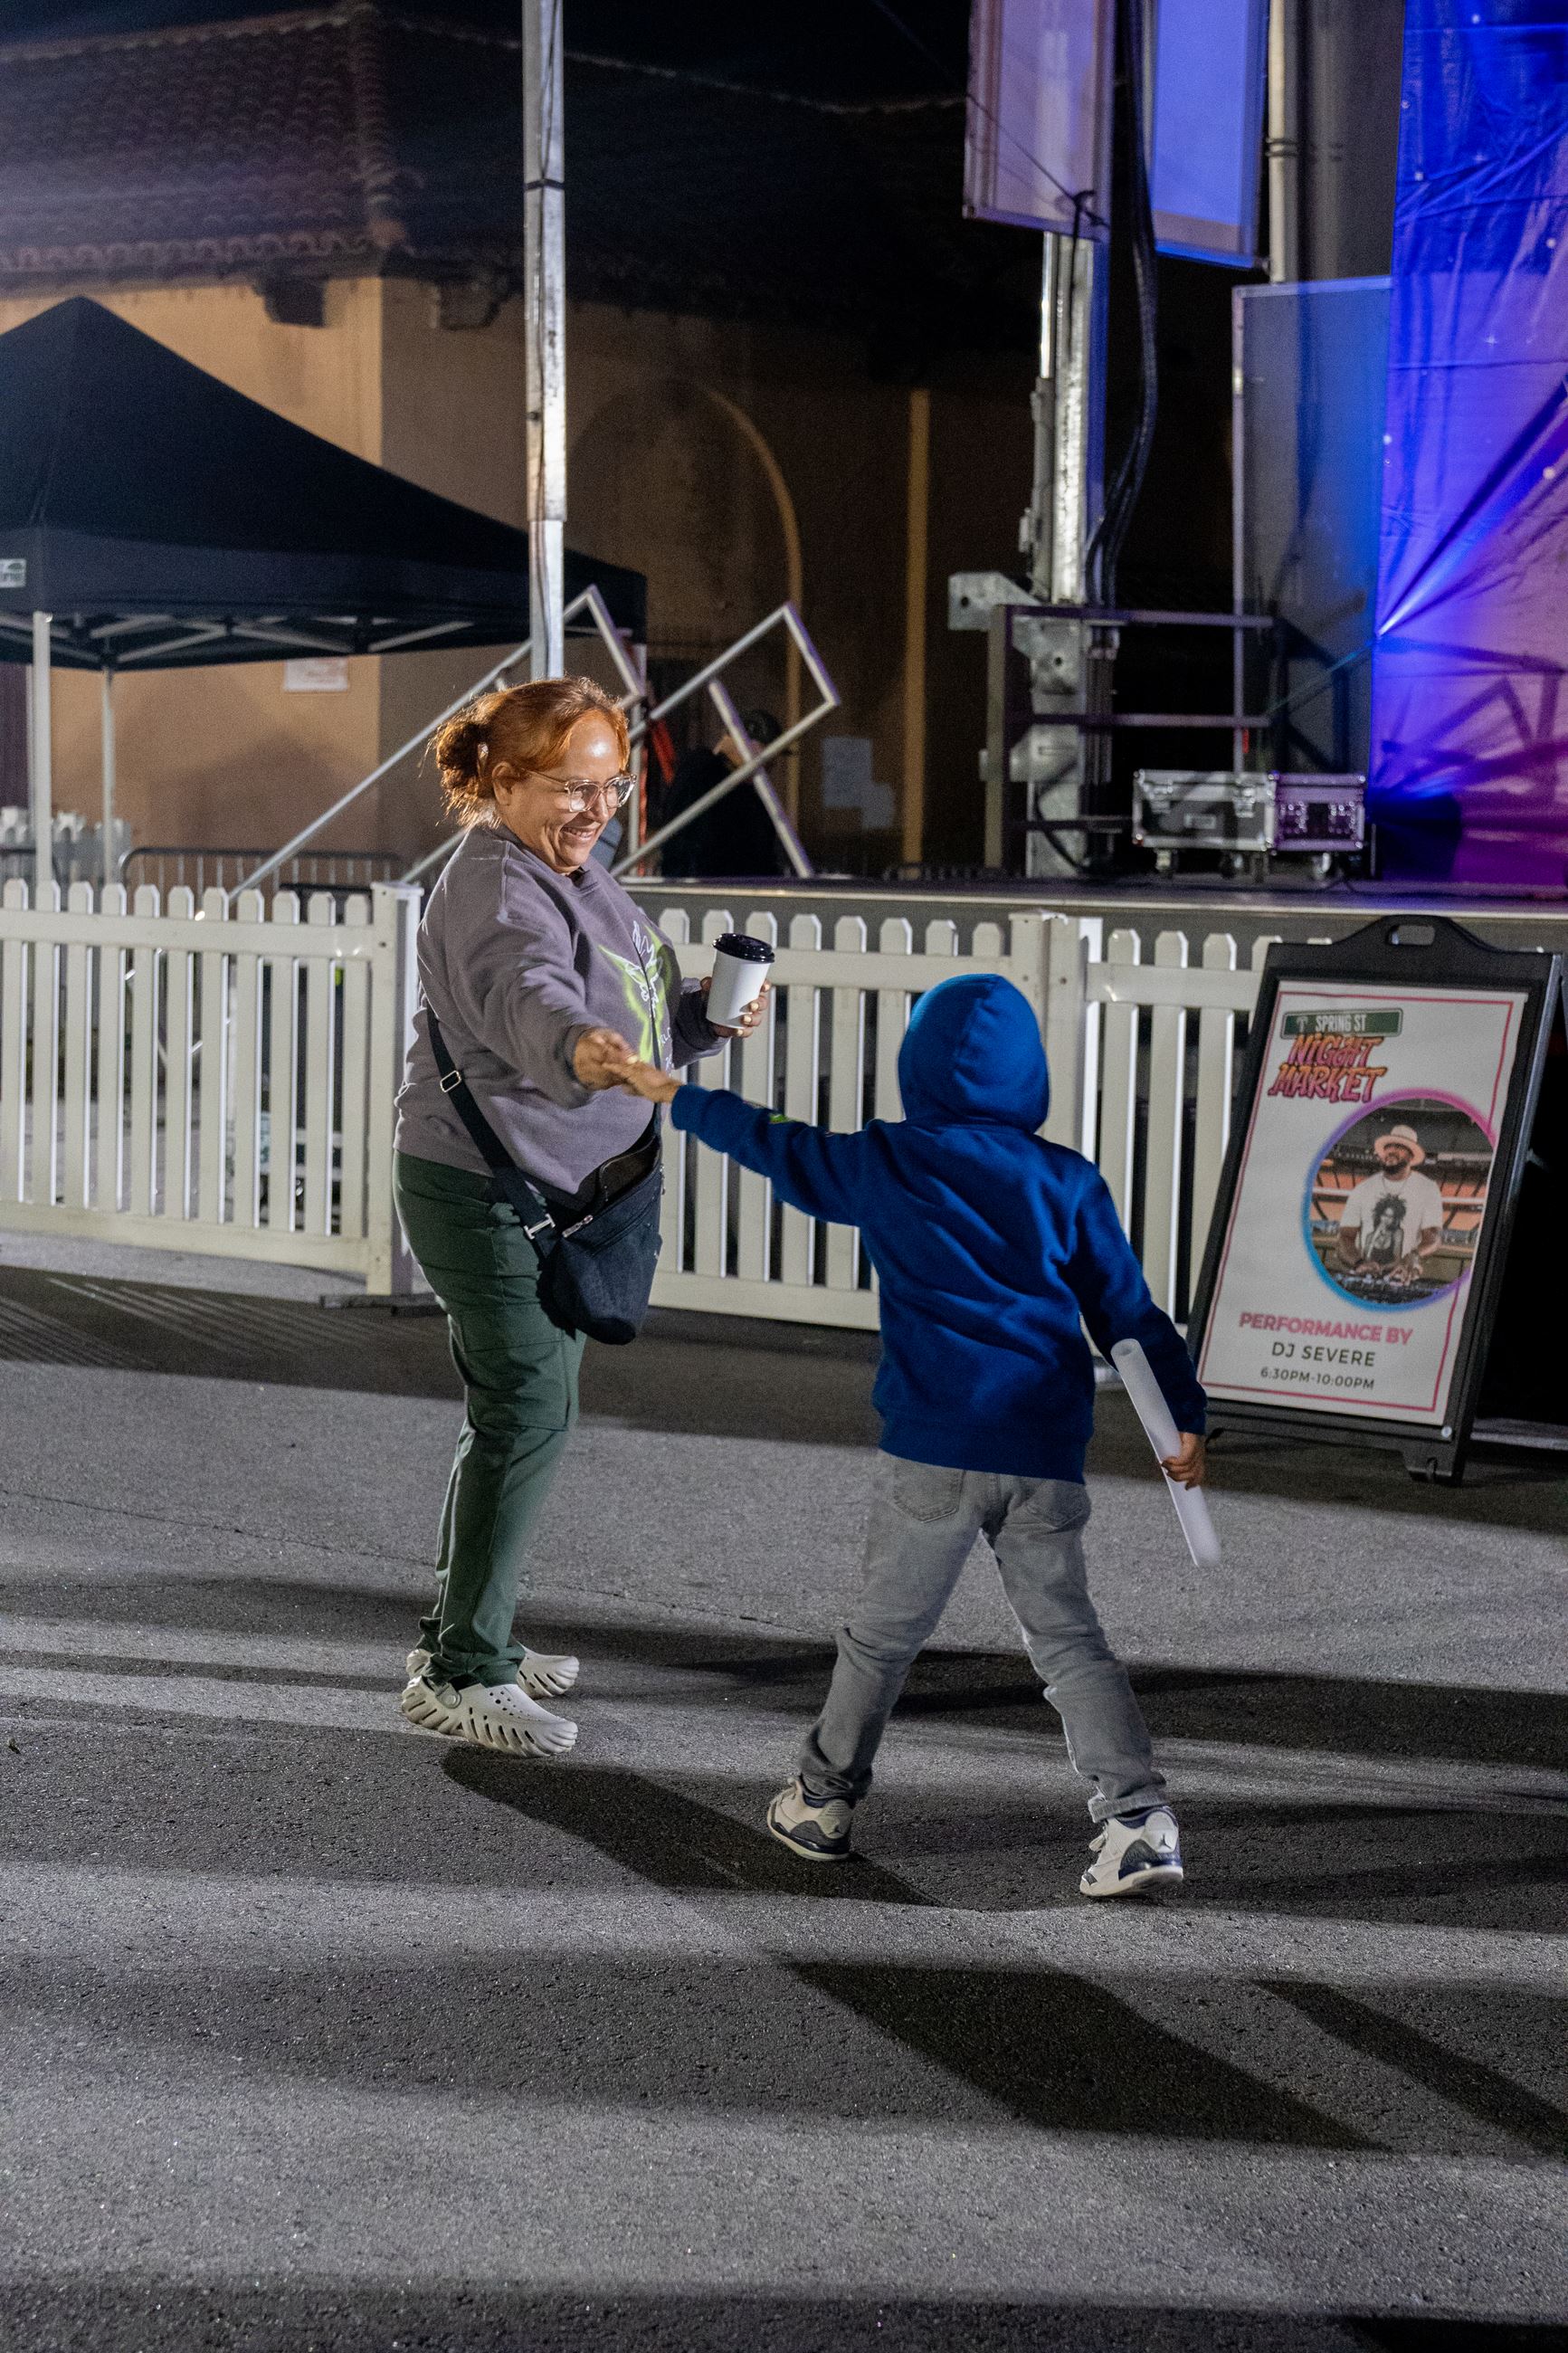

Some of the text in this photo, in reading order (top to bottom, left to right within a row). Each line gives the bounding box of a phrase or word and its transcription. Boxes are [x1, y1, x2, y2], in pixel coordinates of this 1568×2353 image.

[1316, 1014, 1367, 1033] SPRING ST
[1287, 1033, 1385, 1068] NIGHT
[1267, 1062, 1389, 1104] MARKET
[1239, 1311, 1414, 1345] PERFORMANCE BY
[1271, 1341, 1376, 1367] DJ SEVERE
[1260, 1367, 1375, 1390] 6:30PM-10:00PM
